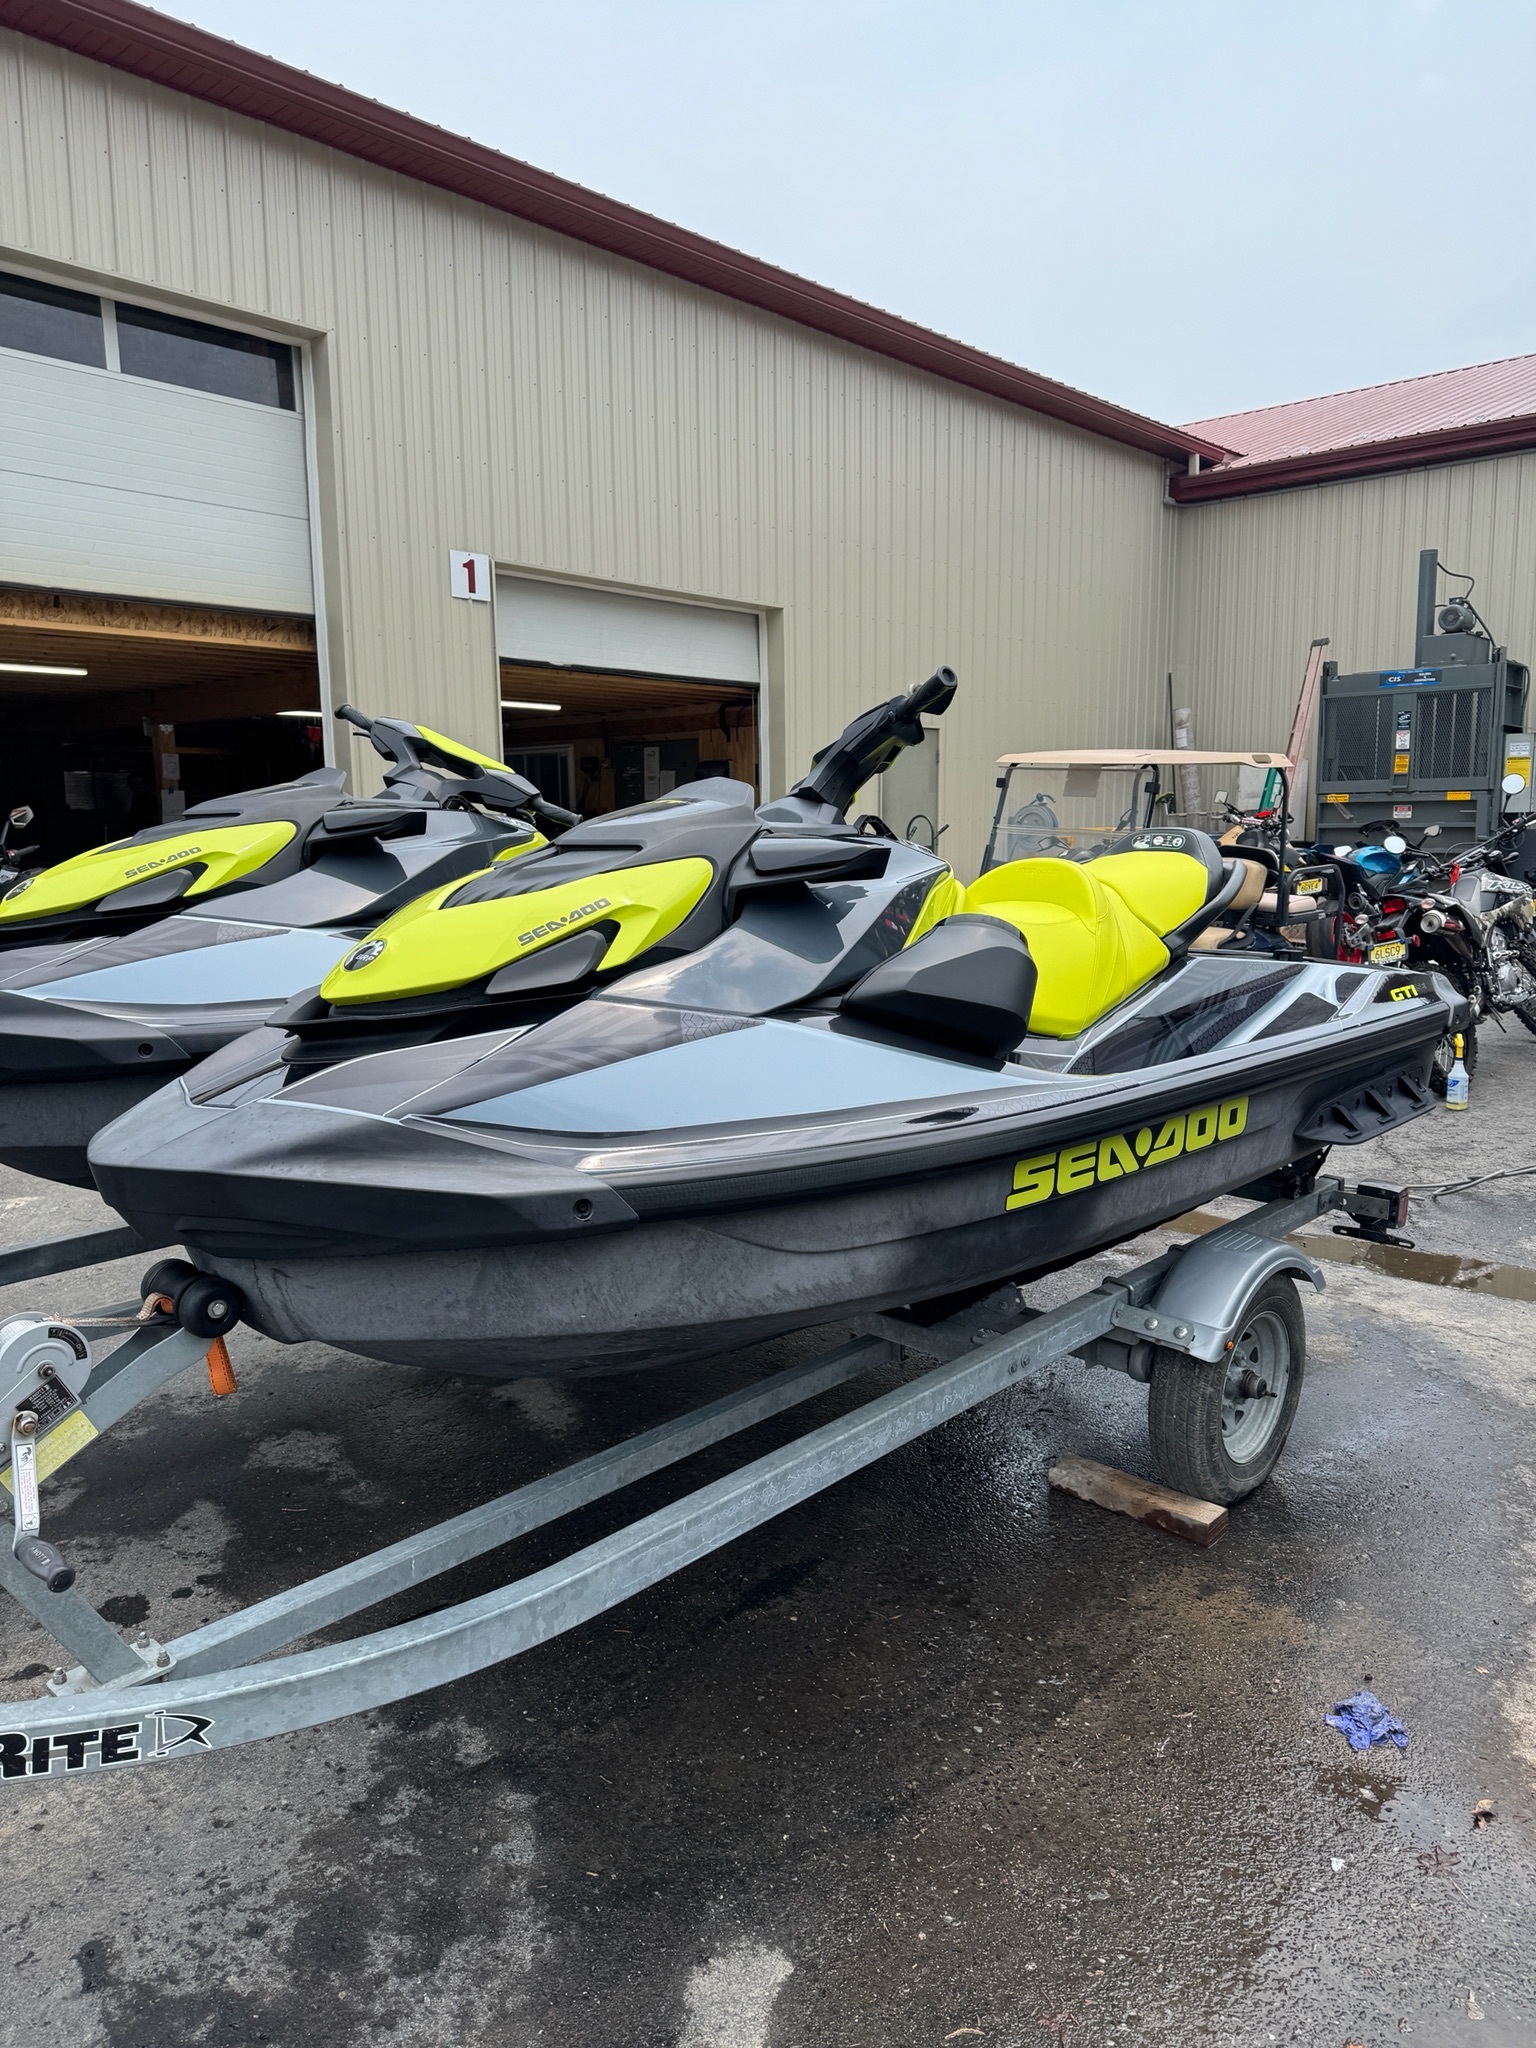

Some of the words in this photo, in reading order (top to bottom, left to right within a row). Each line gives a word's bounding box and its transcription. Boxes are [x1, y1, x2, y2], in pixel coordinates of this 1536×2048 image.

[463, 559, 476, 594] 1
[1487, 880, 1532, 894] KLX
[1375, 945, 1400, 959] 6LSC9
[1390, 984, 1418, 1002] GTI
